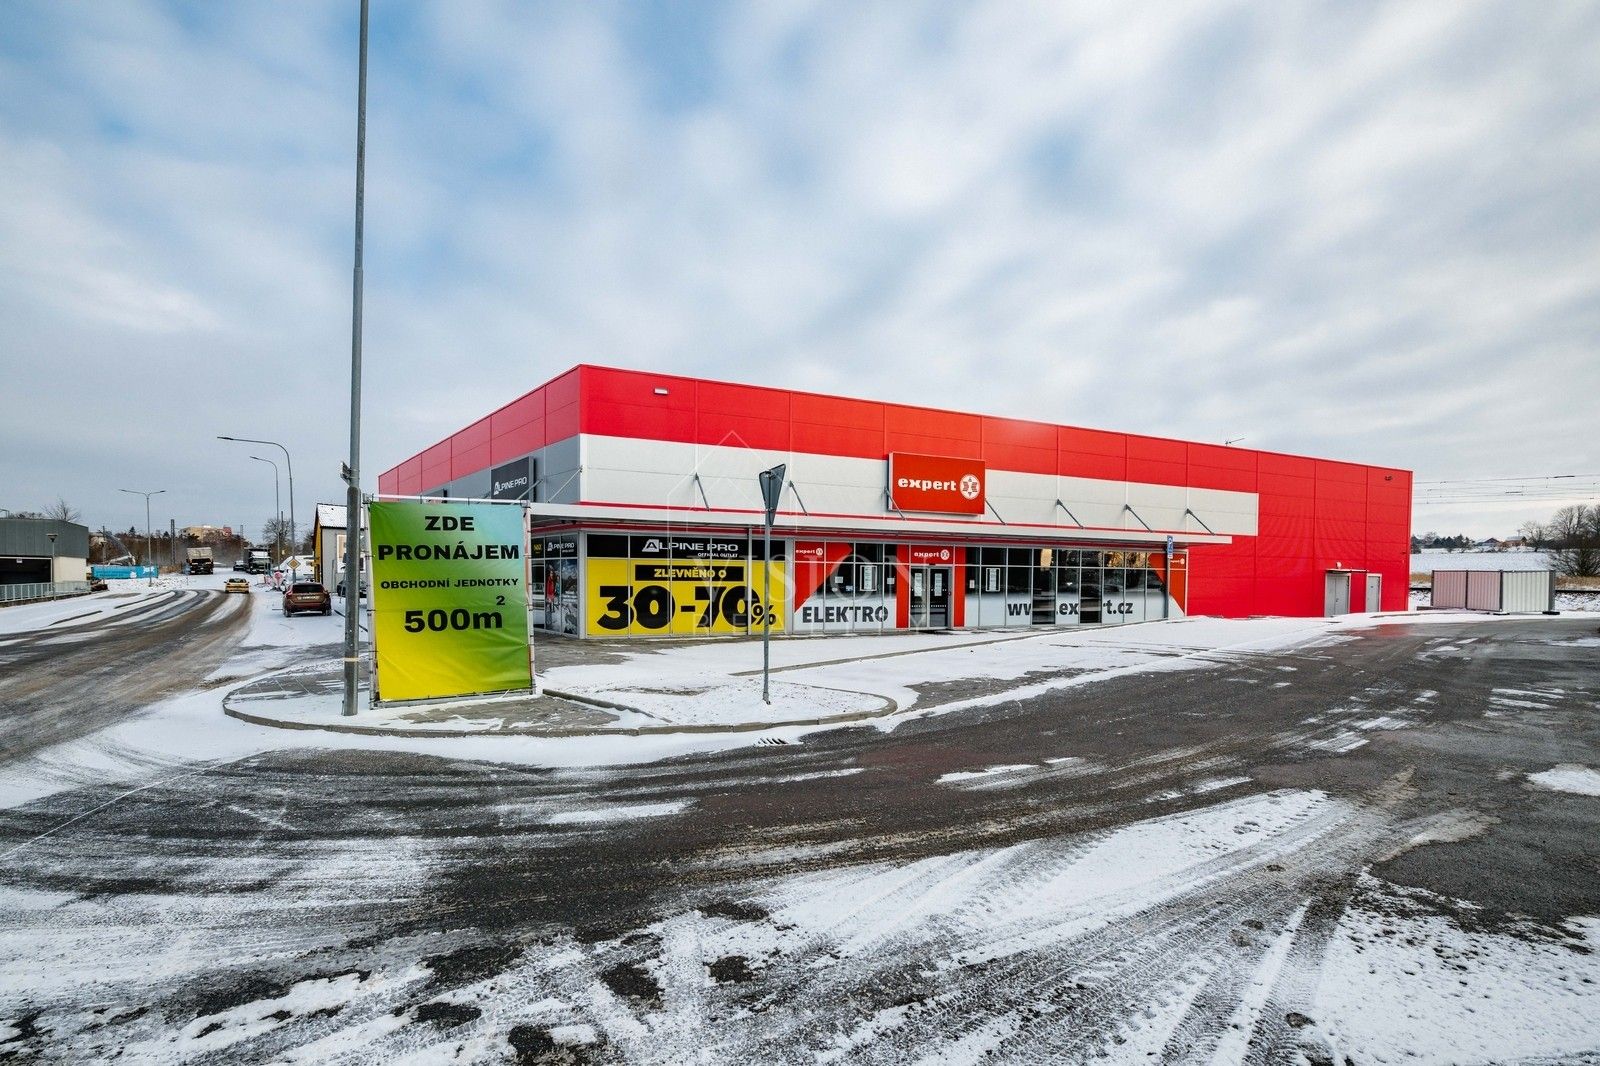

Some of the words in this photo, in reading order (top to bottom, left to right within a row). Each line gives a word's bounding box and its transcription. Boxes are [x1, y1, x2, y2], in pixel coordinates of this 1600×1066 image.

[494, 480, 514, 495] ALPINE
[515, 476, 527, 487] PRO
[897, 478, 957, 492] expert
[425, 516, 475, 531] ZDE
[378, 541, 519, 561] PRONÁJEM
[641, 539, 704, 553] ALPINE
[706, 543, 739, 552] PRO
[654, 567, 715, 578] ZLEVNĚNO
[718, 569, 727, 578] O
[380, 578, 450, 590] OBCHODNÍ
[454, 577, 518, 588] JEDNOTKY
[802, 605, 889, 624] ELEKTRO
